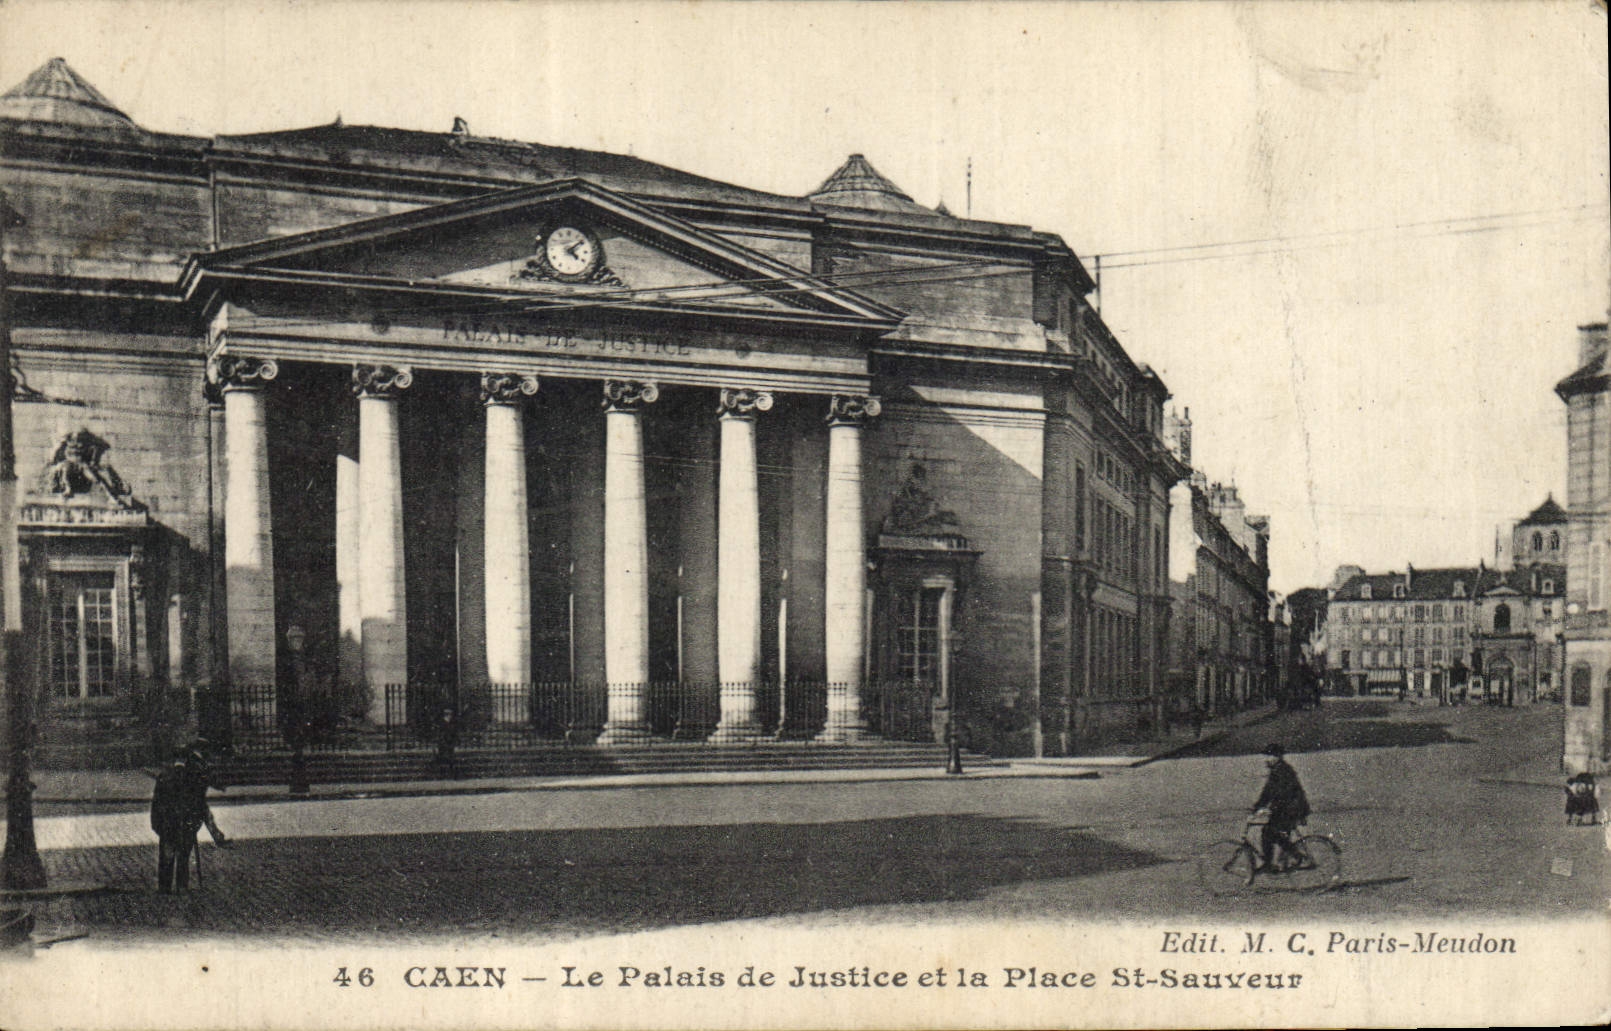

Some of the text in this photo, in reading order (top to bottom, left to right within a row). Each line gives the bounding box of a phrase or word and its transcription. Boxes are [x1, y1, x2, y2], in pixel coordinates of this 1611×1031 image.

[442, 320, 691, 356] PALAIS DE JUSTICE
